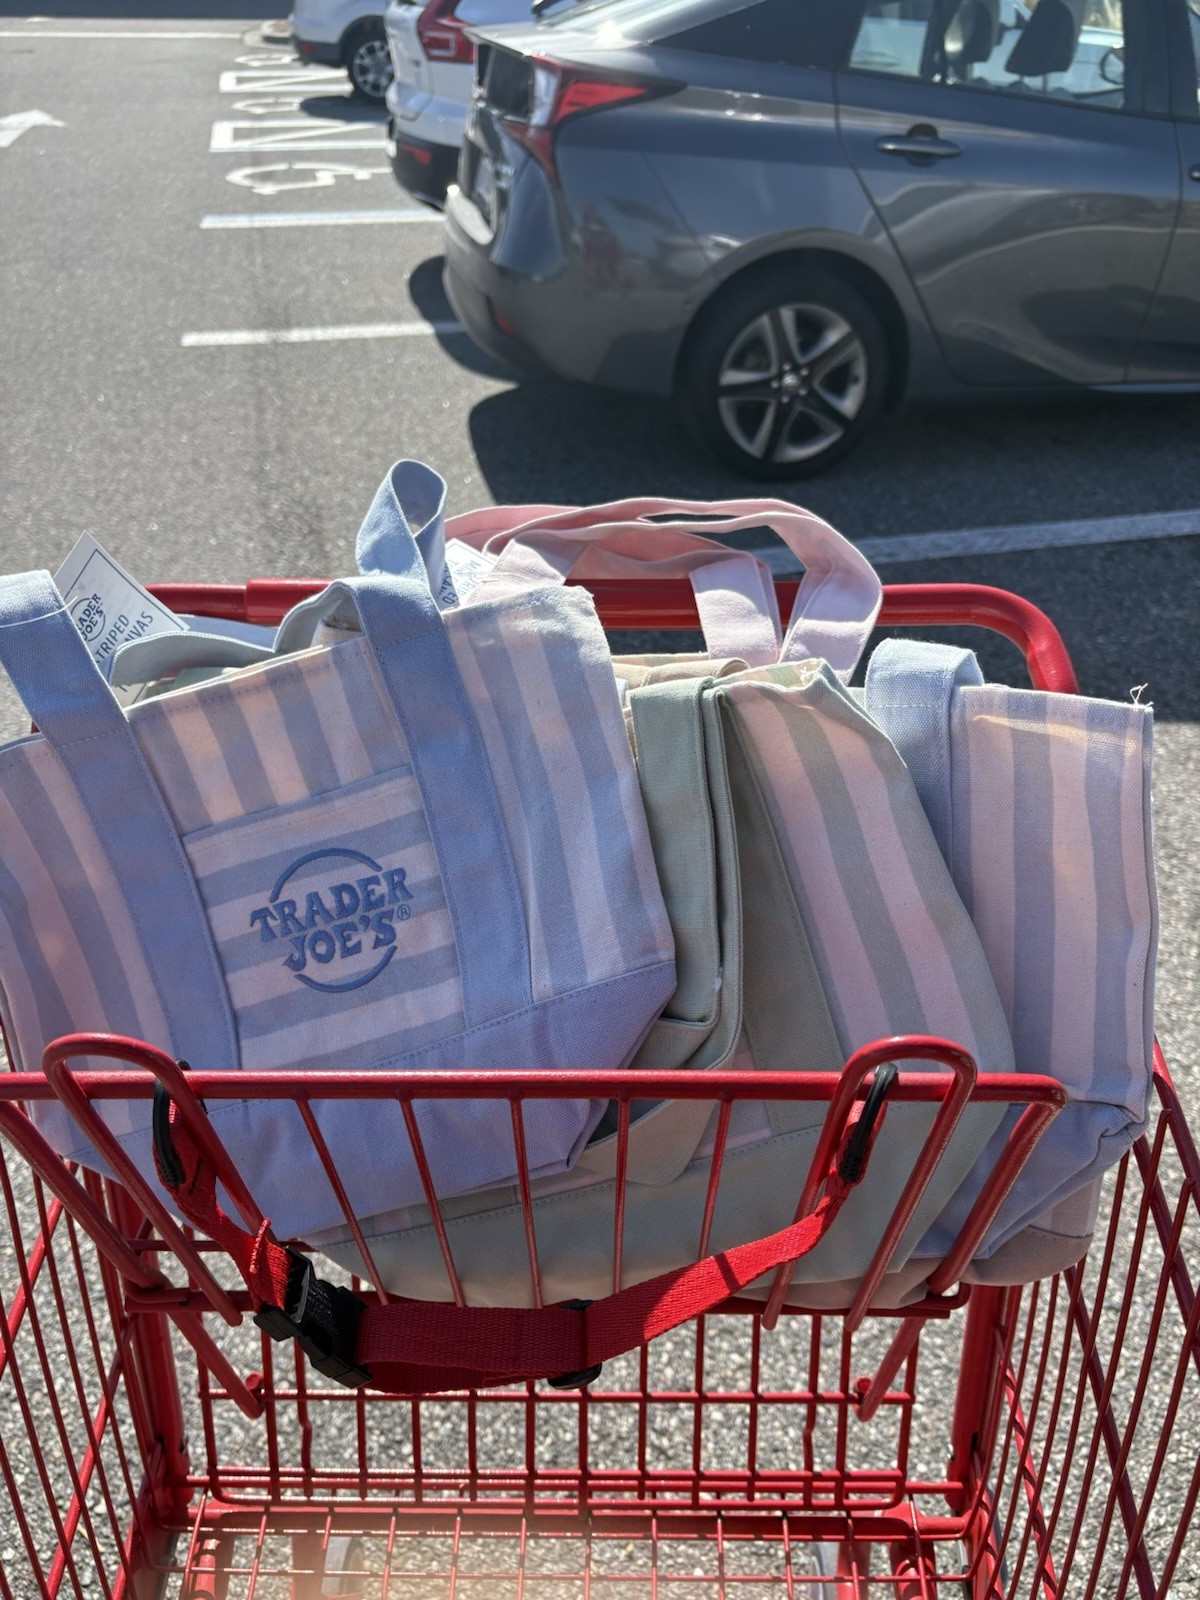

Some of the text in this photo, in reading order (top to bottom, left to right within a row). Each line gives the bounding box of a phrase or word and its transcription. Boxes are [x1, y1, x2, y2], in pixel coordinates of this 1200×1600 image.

[77, 593, 101, 630] ADER
[81, 606, 104, 641] JOE'S
[95, 614, 130, 664] TRIPED
[250, 867, 414, 943] TRADER
[282, 908, 397, 972] JOE'S
